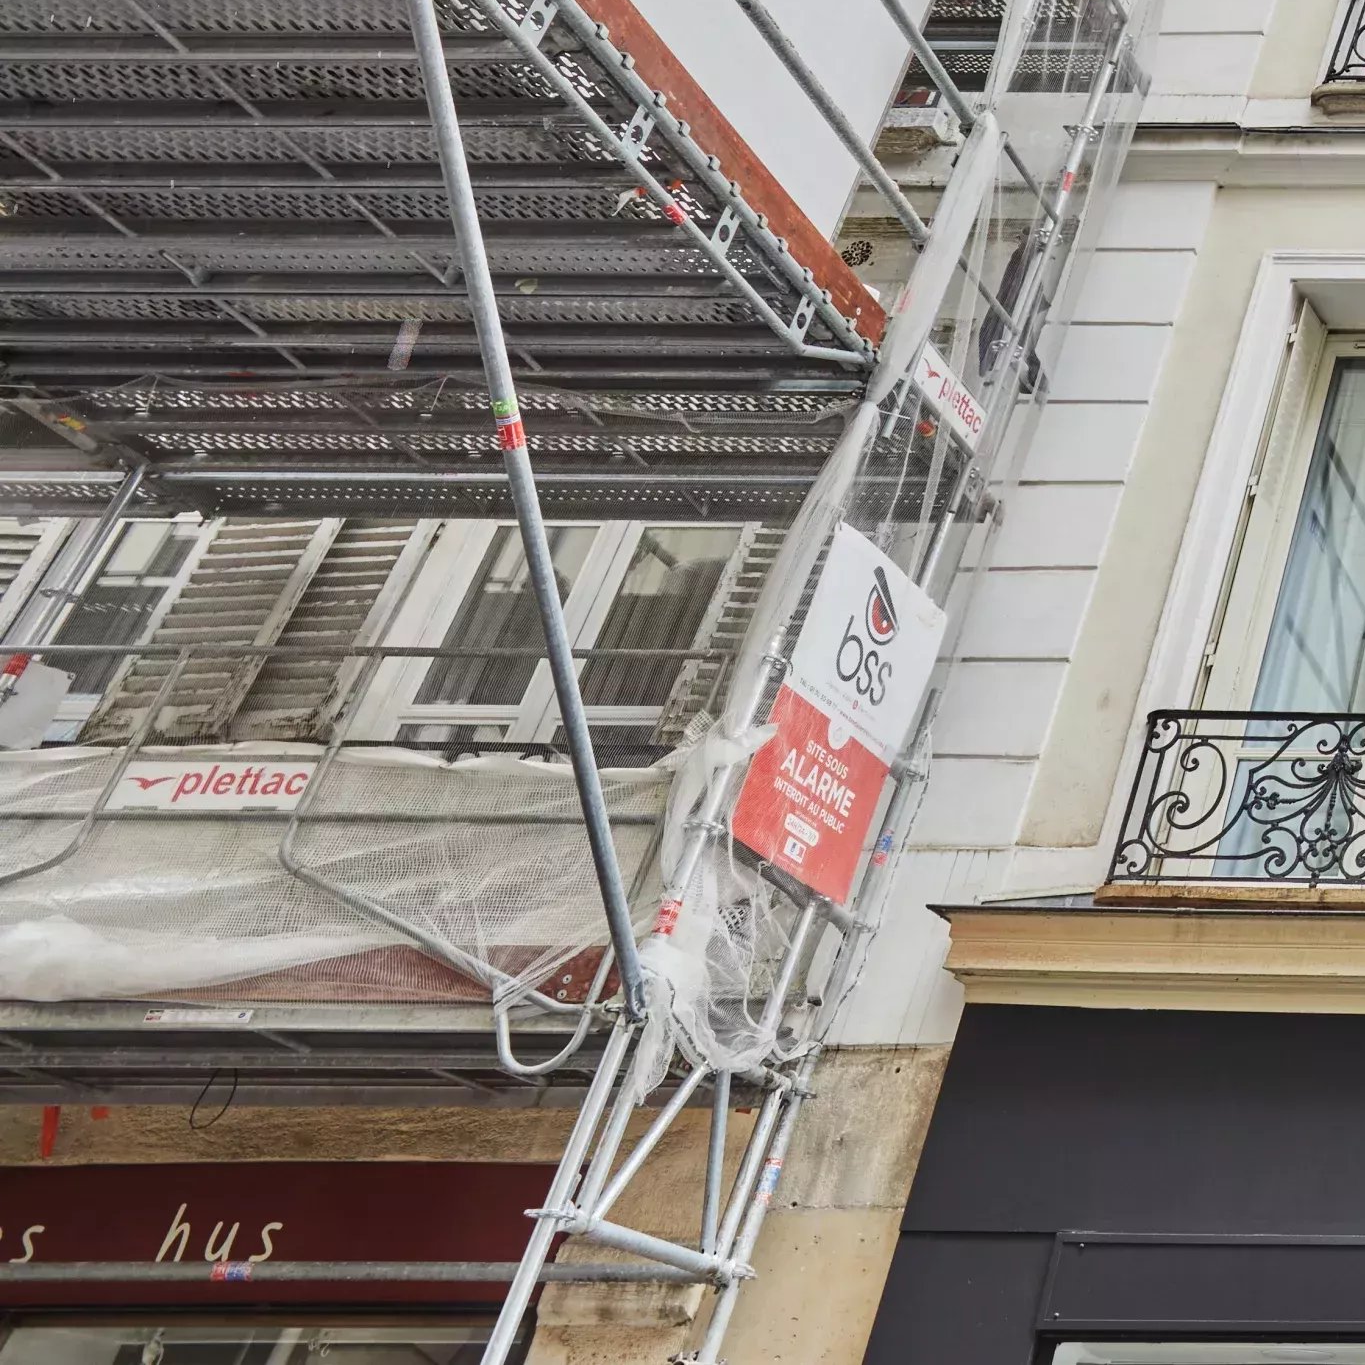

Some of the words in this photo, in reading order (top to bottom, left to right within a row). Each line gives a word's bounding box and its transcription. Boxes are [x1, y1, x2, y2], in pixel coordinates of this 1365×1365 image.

[938, 377, 982, 434] plettac
[172, 768, 310, 802] plettac
[780, 747, 856, 818] ALARME
[805, 739, 824, 763] SITE
[825, 754, 849, 780] SOUS
[773, 776, 810, 808] INTERDIT
[807, 802, 820, 816] AU
[818, 808, 846, 835] PUBLIC
[155, 1203, 284, 1263] hus
